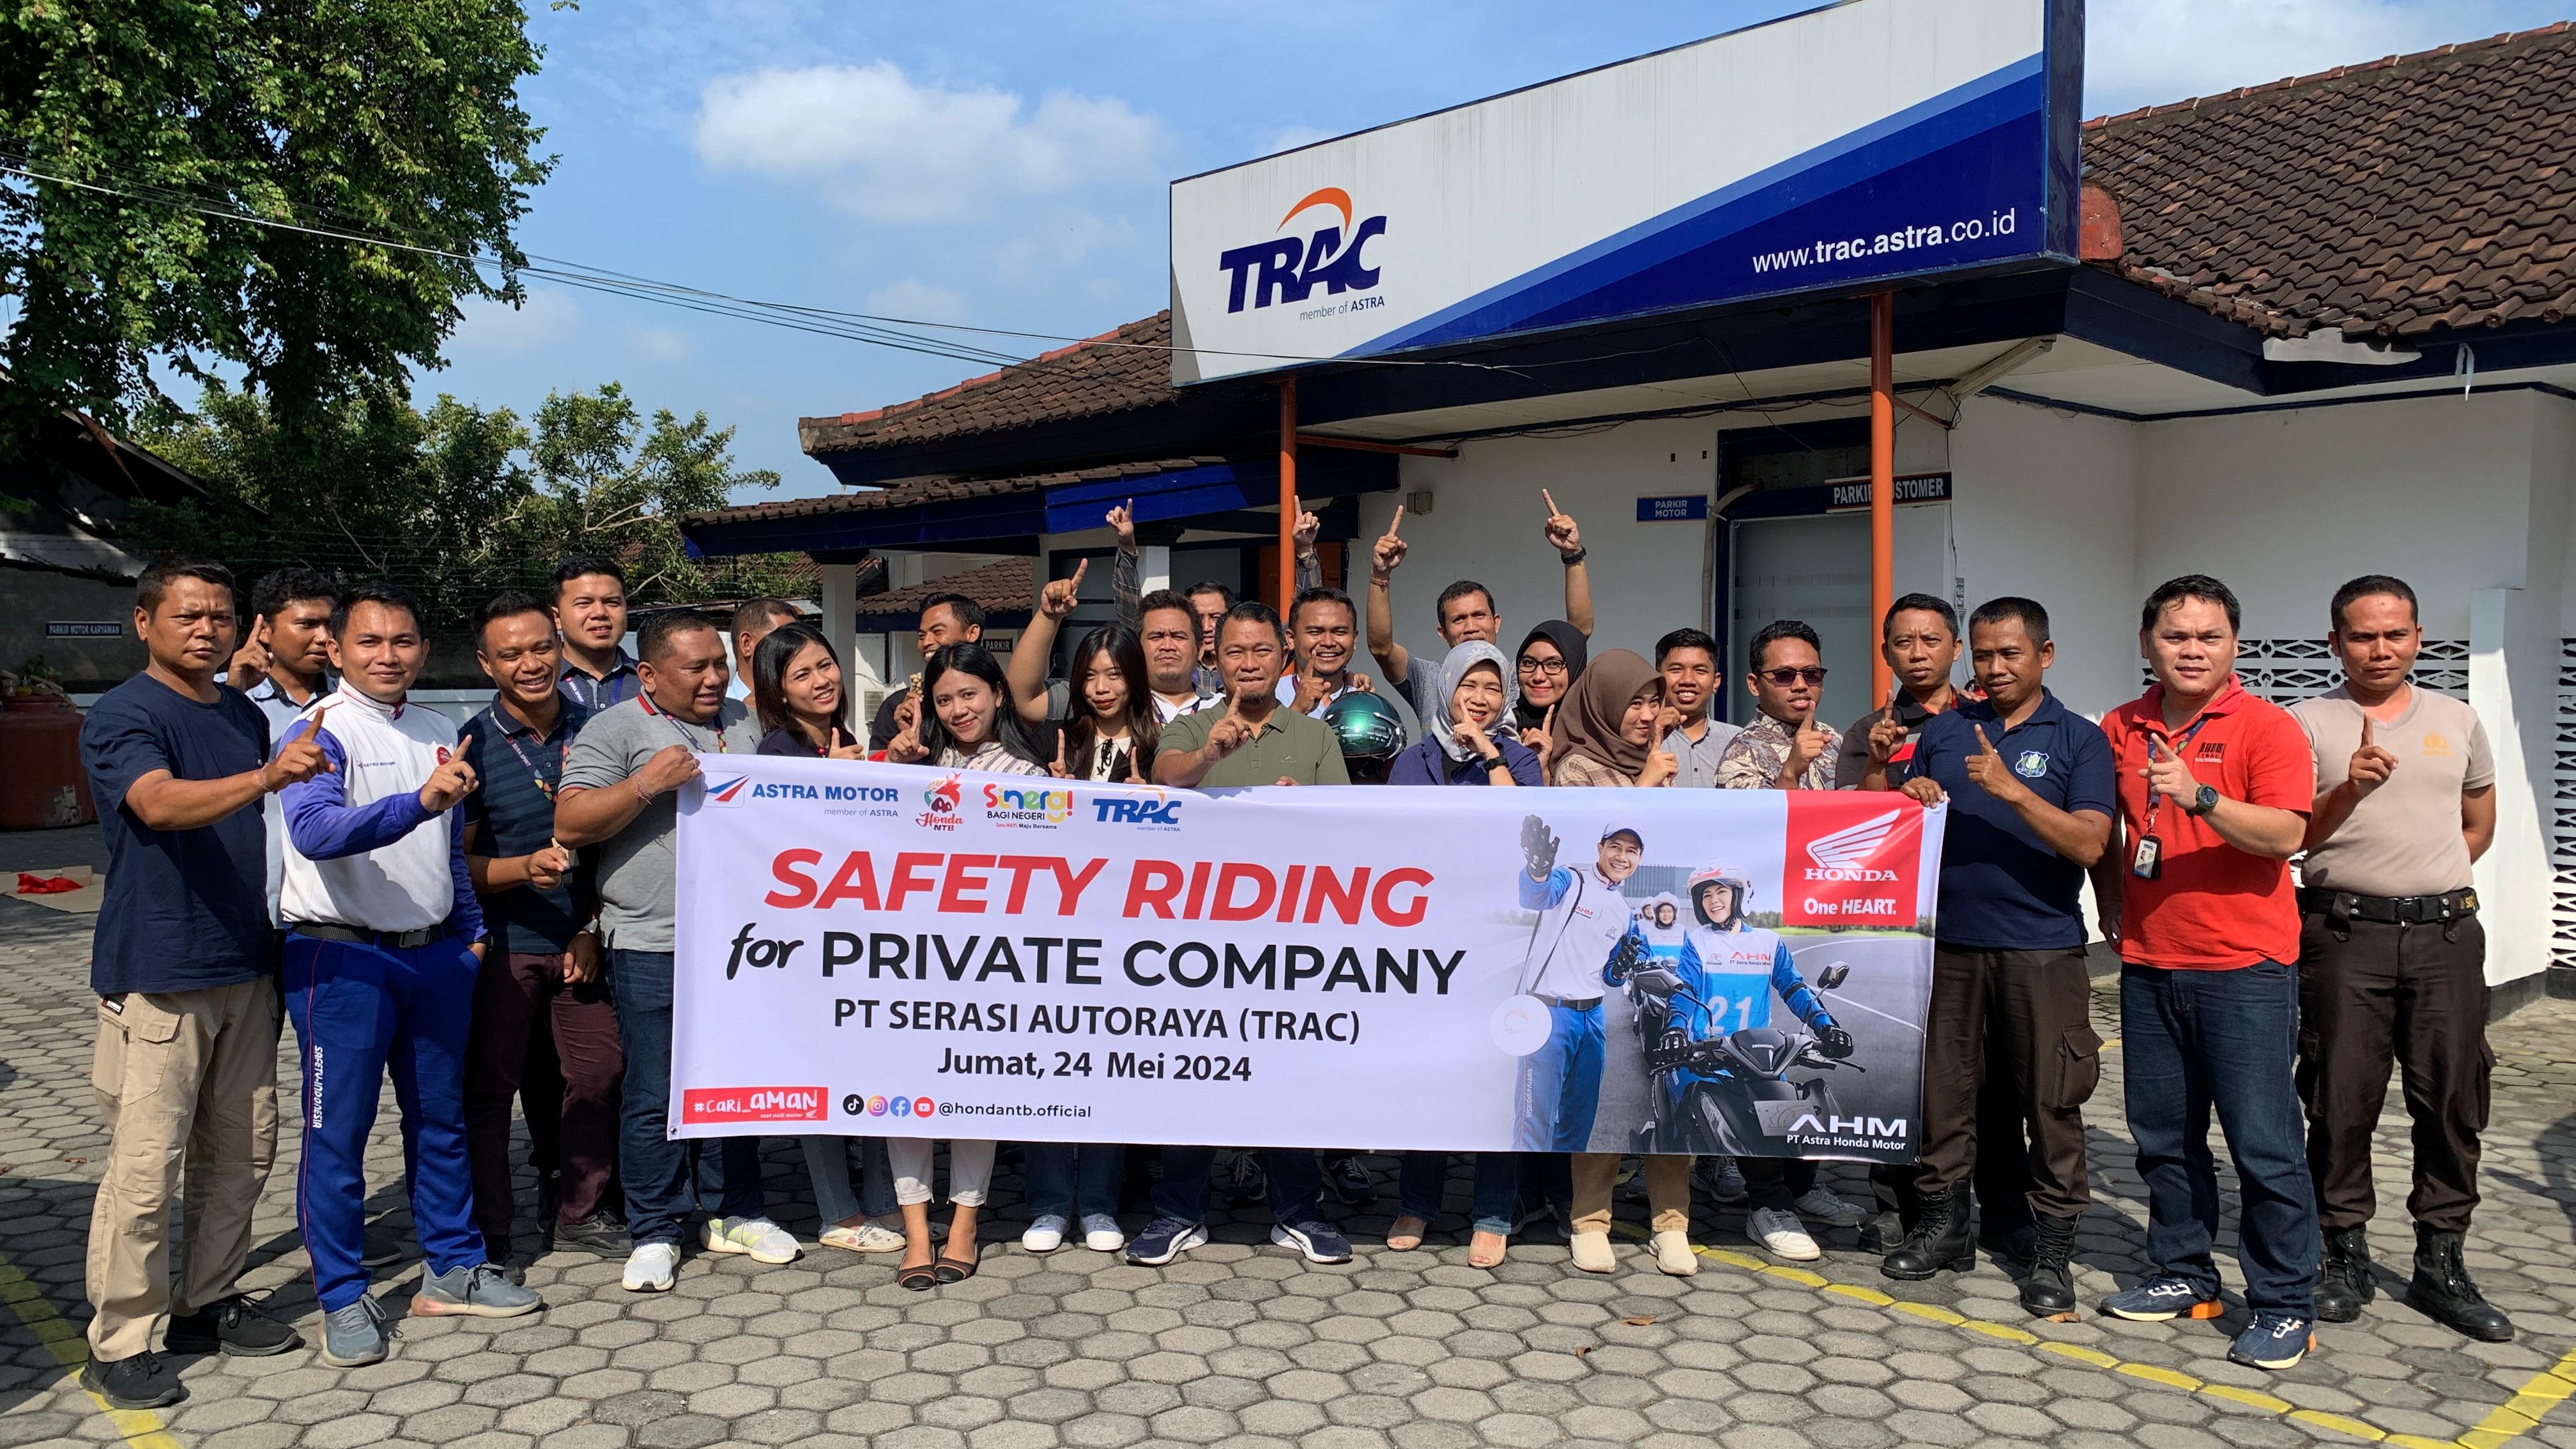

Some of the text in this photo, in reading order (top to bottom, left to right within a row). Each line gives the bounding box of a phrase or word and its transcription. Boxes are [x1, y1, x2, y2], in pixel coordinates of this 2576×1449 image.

[1752, 208, 2015, 273] www.trac.astra.co.id
[1220, 215, 1387, 314] TRAC
[1300, 295, 1385, 321] member of ASTRA
[1655, 500, 1687, 509] PARKIR
[1655, 509, 1687, 518] MOTOR
[49, 625, 70, 634] PARKIR
[70, 625, 89, 634] MOTOR
[985, 640, 1010, 651] PARKIR
[752, 784, 899, 802] ASTRA MOTOR
[824, 808, 899, 817] member of ASTRA
[915, 813, 964, 827] Honda
[987, 811, 1045, 820] BAGI NEGERI
[1092, 799, 1182, 824] TRAC
[1804, 868, 1899, 881] HONDA
[763, 848, 1435, 927] SAFETY RIDING
[1804, 898, 1897, 916] One HEART.
[726, 923, 1467, 995] for PRIVATE COMPANY
[835, 999, 1360, 1045] PT SERASI AUTORAYA (TRAC)
[1703, 996, 1751, 1034] 21
[937, 1047, 1252, 1082] Jumat, 24 Mei 2024
[939, 1102, 1091, 1117] @hondantb.official
[1788, 1114, 1907, 1137] AHM
[1787, 1134, 1906, 1150] PT Astra Honda Motor
